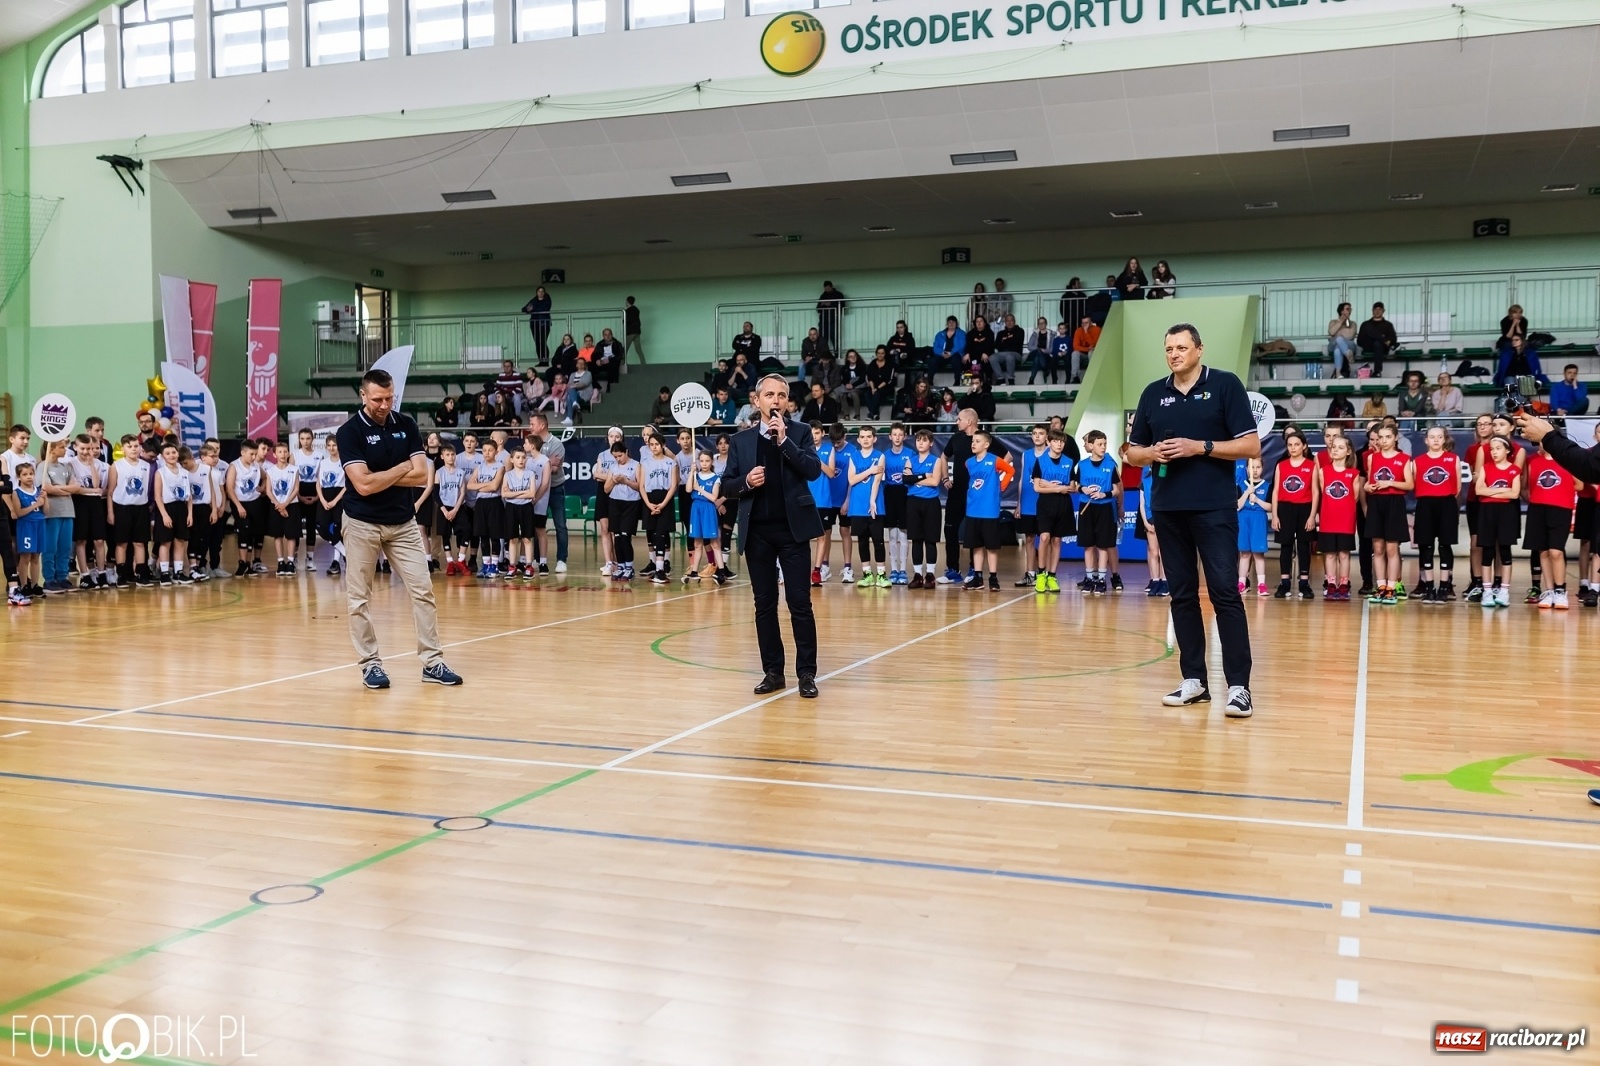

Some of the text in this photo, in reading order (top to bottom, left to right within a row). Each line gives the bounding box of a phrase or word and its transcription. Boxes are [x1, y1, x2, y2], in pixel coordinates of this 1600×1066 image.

[840, 8, 994, 53] OŚRODEK
[1006, 0, 1143, 36] SPORTU
[1496, 223, 1507, 234] C
[956, 252, 966, 261] B
[550, 274, 561, 282] A
[673, 399, 711, 413] SPURS
[1251, 399, 1268, 414] DER
[41, 415, 67, 424] KINGS
[562, 462, 598, 480] CIB
[24, 537, 31, 549] 5
